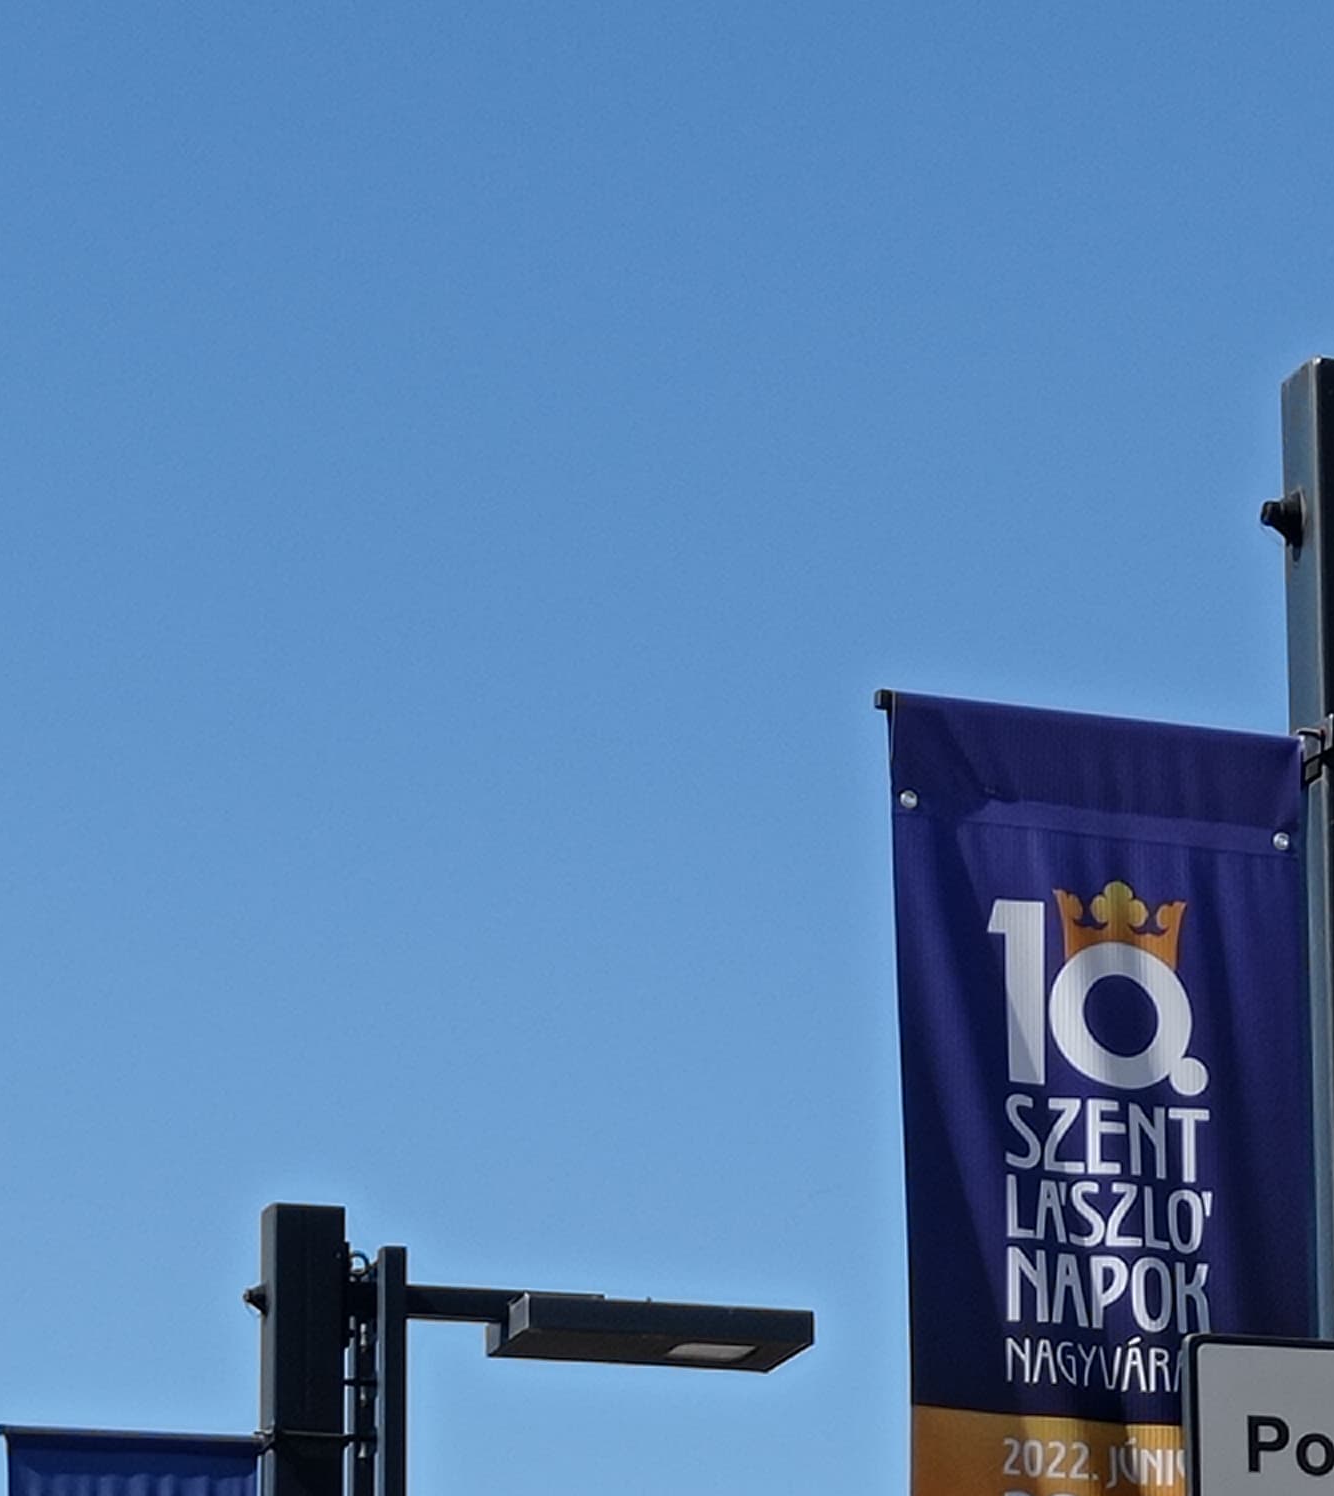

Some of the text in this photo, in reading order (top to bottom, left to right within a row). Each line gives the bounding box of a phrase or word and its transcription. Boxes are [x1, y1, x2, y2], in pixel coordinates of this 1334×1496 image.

[1005, 1093, 1211, 1184] SZENT
[1006, 1174, 1213, 1254] LÁSZLÓ
[1006, 1246, 1211, 1334] NAPOK
[1002, 1437, 1099, 1480] 2022.
